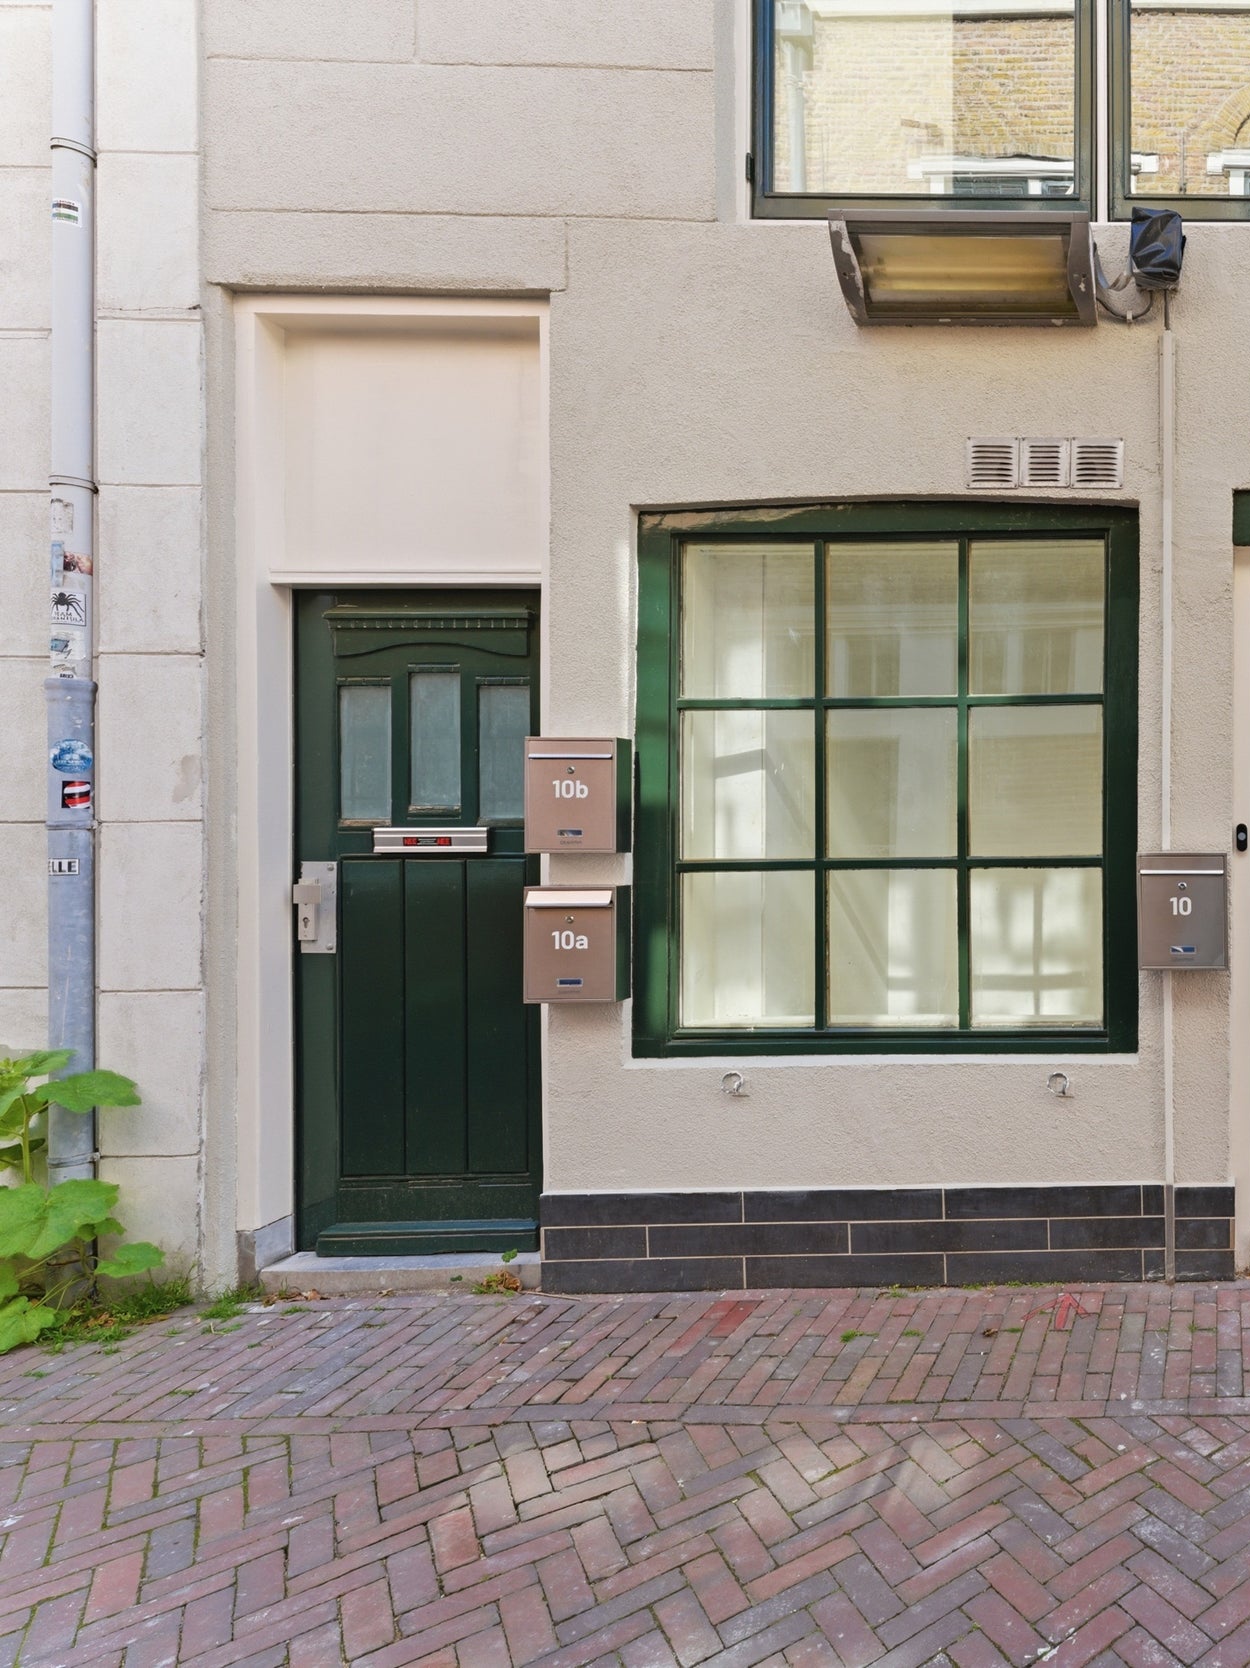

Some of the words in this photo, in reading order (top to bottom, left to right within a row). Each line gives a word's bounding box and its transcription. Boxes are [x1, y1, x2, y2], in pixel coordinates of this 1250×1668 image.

[552, 780, 588, 799] 10b
[48, 860, 77, 873] LLE
[1169, 897, 1192, 916] 10
[551, 930, 589, 950] 10a
